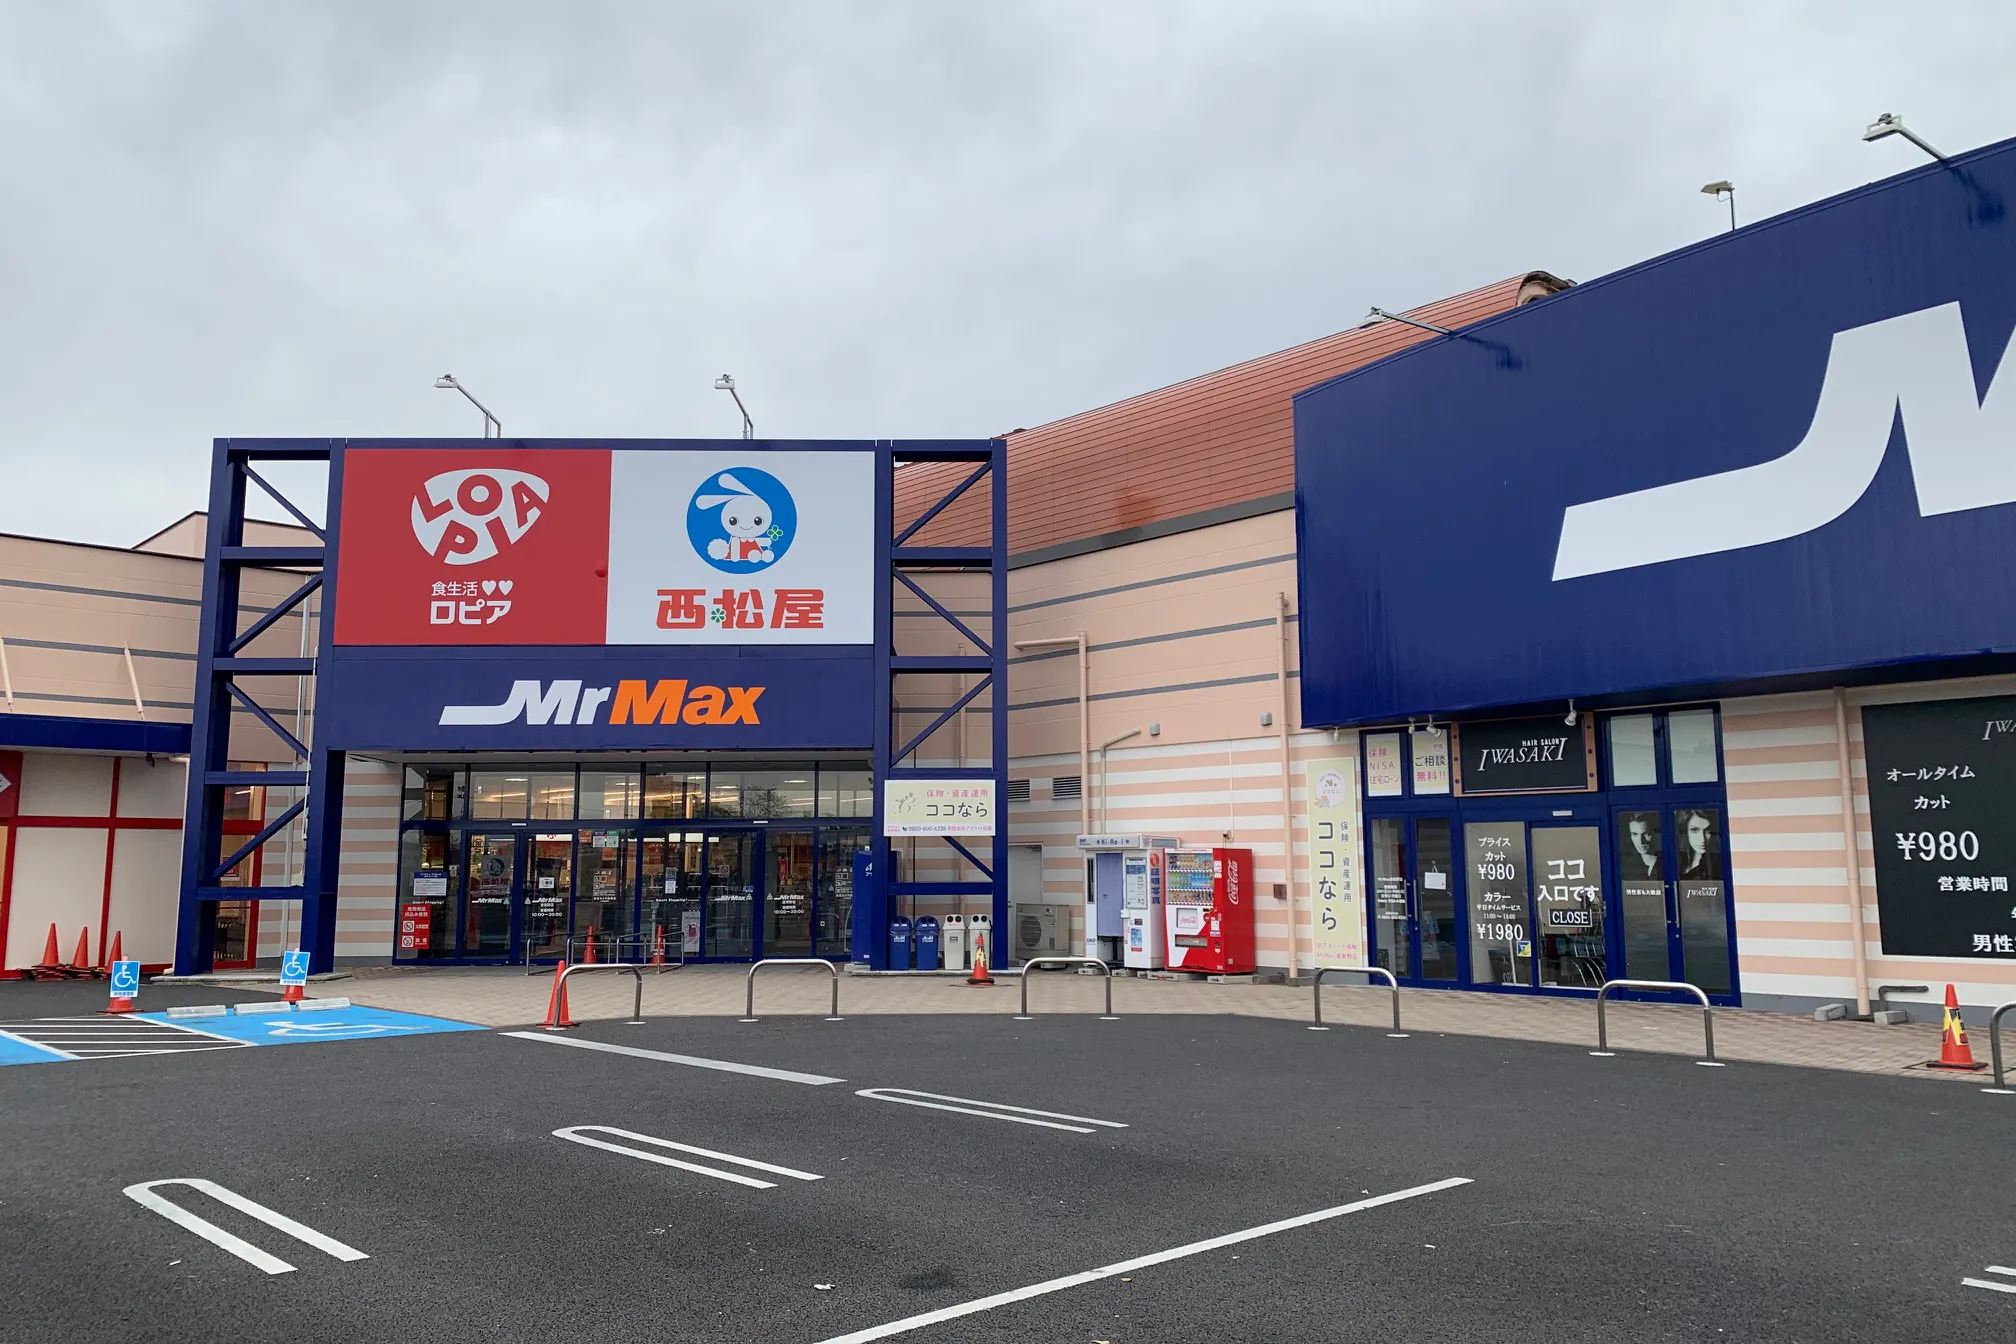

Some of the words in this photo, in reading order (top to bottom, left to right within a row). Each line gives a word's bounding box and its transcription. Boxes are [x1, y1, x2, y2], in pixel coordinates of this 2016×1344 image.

[411, 469, 549, 565] LOPIA
[431, 581, 478, 596] 食生活
[430, 599, 512, 625] ロピア
[656, 588, 824, 629] 西松屋
[1522, 739, 1538, 747] HAIR
[1540, 738, 1560, 746] SALON
[1368, 748, 1388, 758] 保険
[1415, 755, 1446, 767] ご相談
[1477, 737, 1568, 771] IWASAKI
[1369, 761, 1395, 770] NISA
[1886, 765, 1976, 782] オールタイム
[1369, 775, 1400, 785] 住宅ローン
[926, 789, 988, 798] 保険・資産運用
[926, 802, 988, 817] ココなら
[1914, 794, 1951, 810] カット
[1895, 830, 1980, 861] ¥980
[1340, 821, 1352, 902] 保険・資産運用
[1485, 851, 1506, 861] カット
[1318, 822, 1337, 931] ココなら
[1477, 863, 1515, 880] ¥980
[1547, 859, 1585, 880] ココ
[1937, 876, 2008, 892] 営業時間
[1484, 892, 1511, 902] カラー
[1537, 885, 1600, 902] 入口です
[1686, 887, 1718, 898] IWASAKI
[1552, 911, 1589, 924] CLOSE
[1476, 923, 1523, 940] ¥1980
[1973, 934, 2016, 952] 男性
